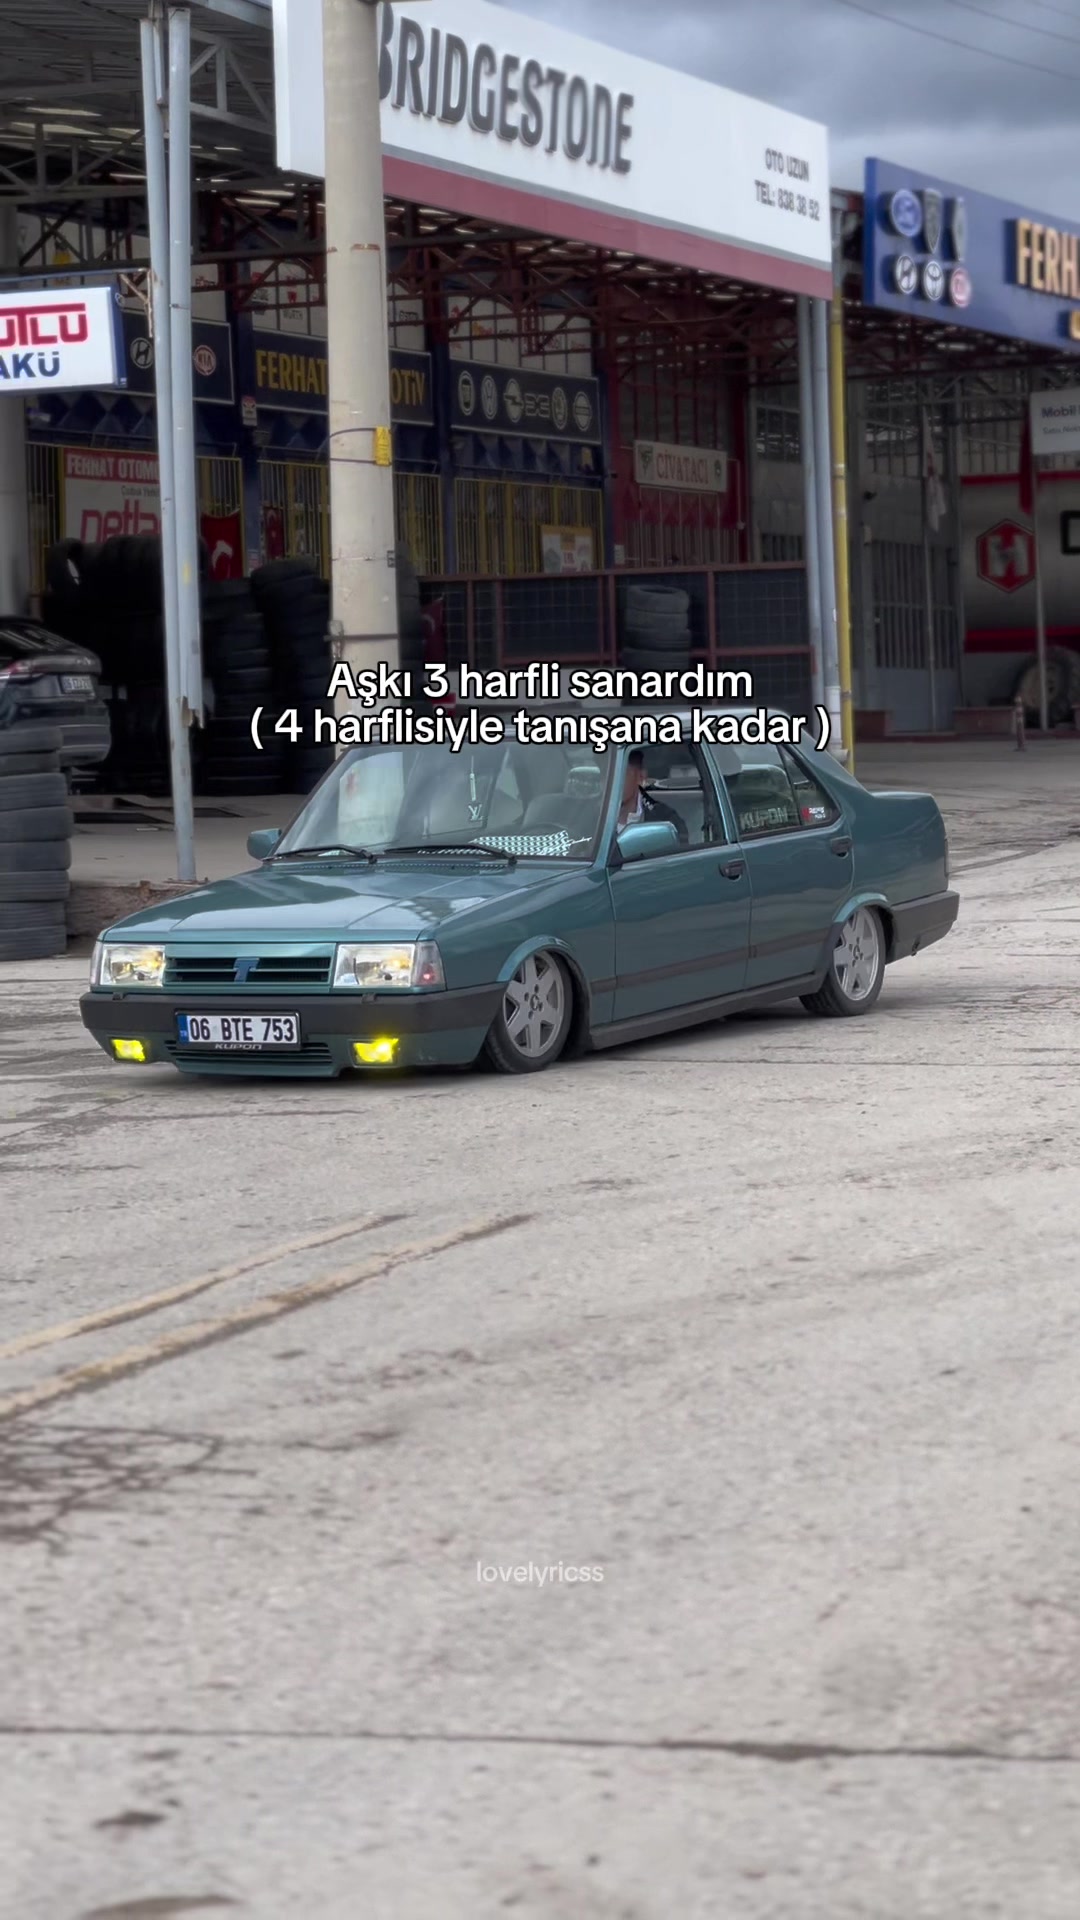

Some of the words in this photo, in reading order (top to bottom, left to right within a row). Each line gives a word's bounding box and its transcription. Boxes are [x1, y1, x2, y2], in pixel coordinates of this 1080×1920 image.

[377, 2, 634, 174] BRIDGESTONE
[765, 148, 784, 174] OTO
[786, 155, 809, 182] UZUN
[778, 187, 794, 212] 838
[796, 194, 807, 216] 38
[809, 198, 820, 221] 52
[1017, 218, 1080, 300] FERH
[256, 349, 329, 396] FERHAT
[1041, 404, 1077, 418] Mobil
[67, 453, 116, 479] FERHAT
[190, 1018, 210, 1041] 06
[221, 1018, 253, 1041] BTE
[261, 1018, 294, 1041] 753
